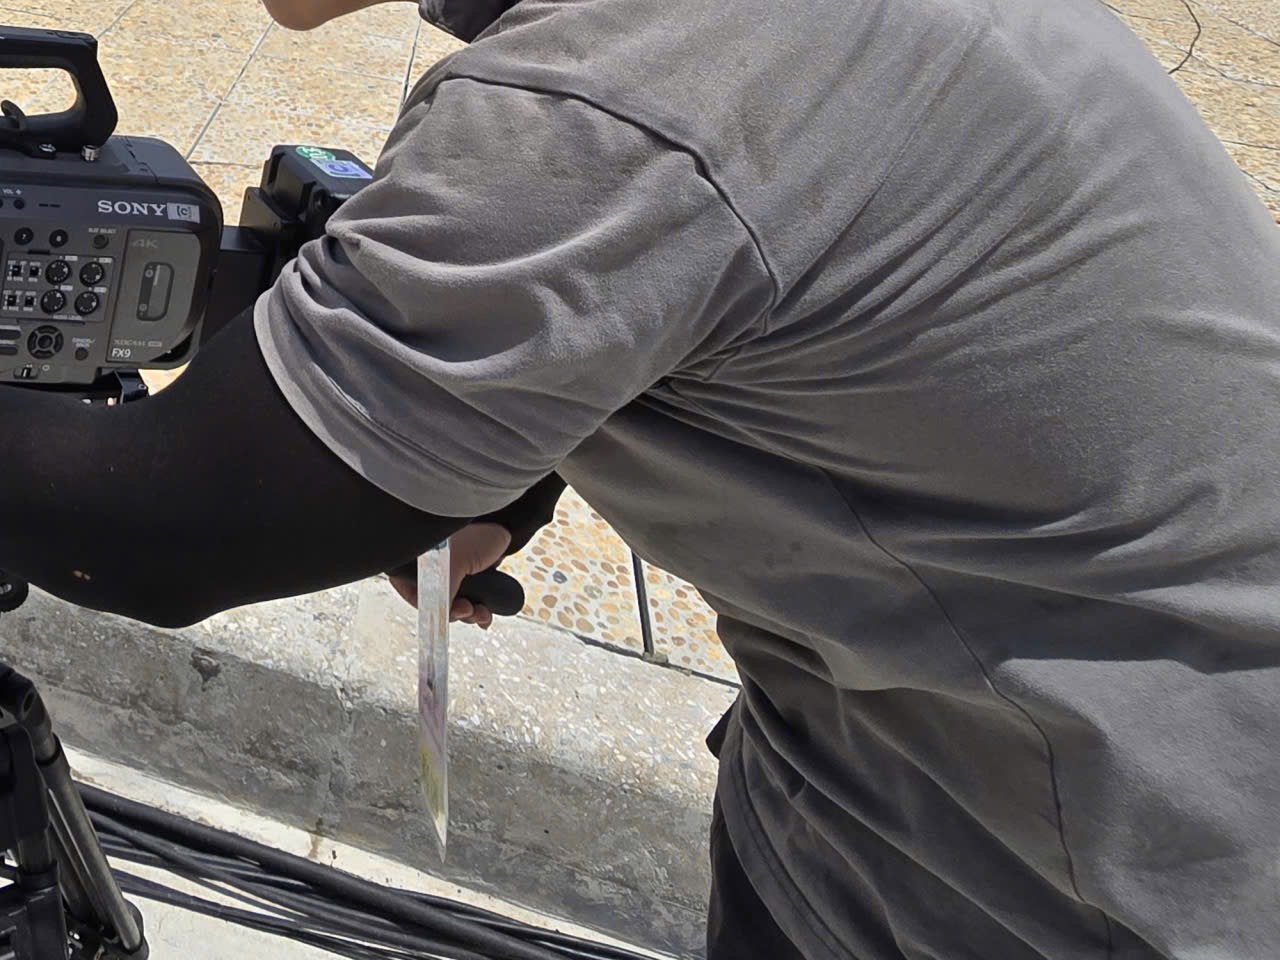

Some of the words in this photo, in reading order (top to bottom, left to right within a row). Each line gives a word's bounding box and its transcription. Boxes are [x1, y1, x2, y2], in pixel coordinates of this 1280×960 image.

[97, 199, 167, 217] SONY
[131, 239, 159, 249] 4K
[111, 347, 132, 358] FX9
